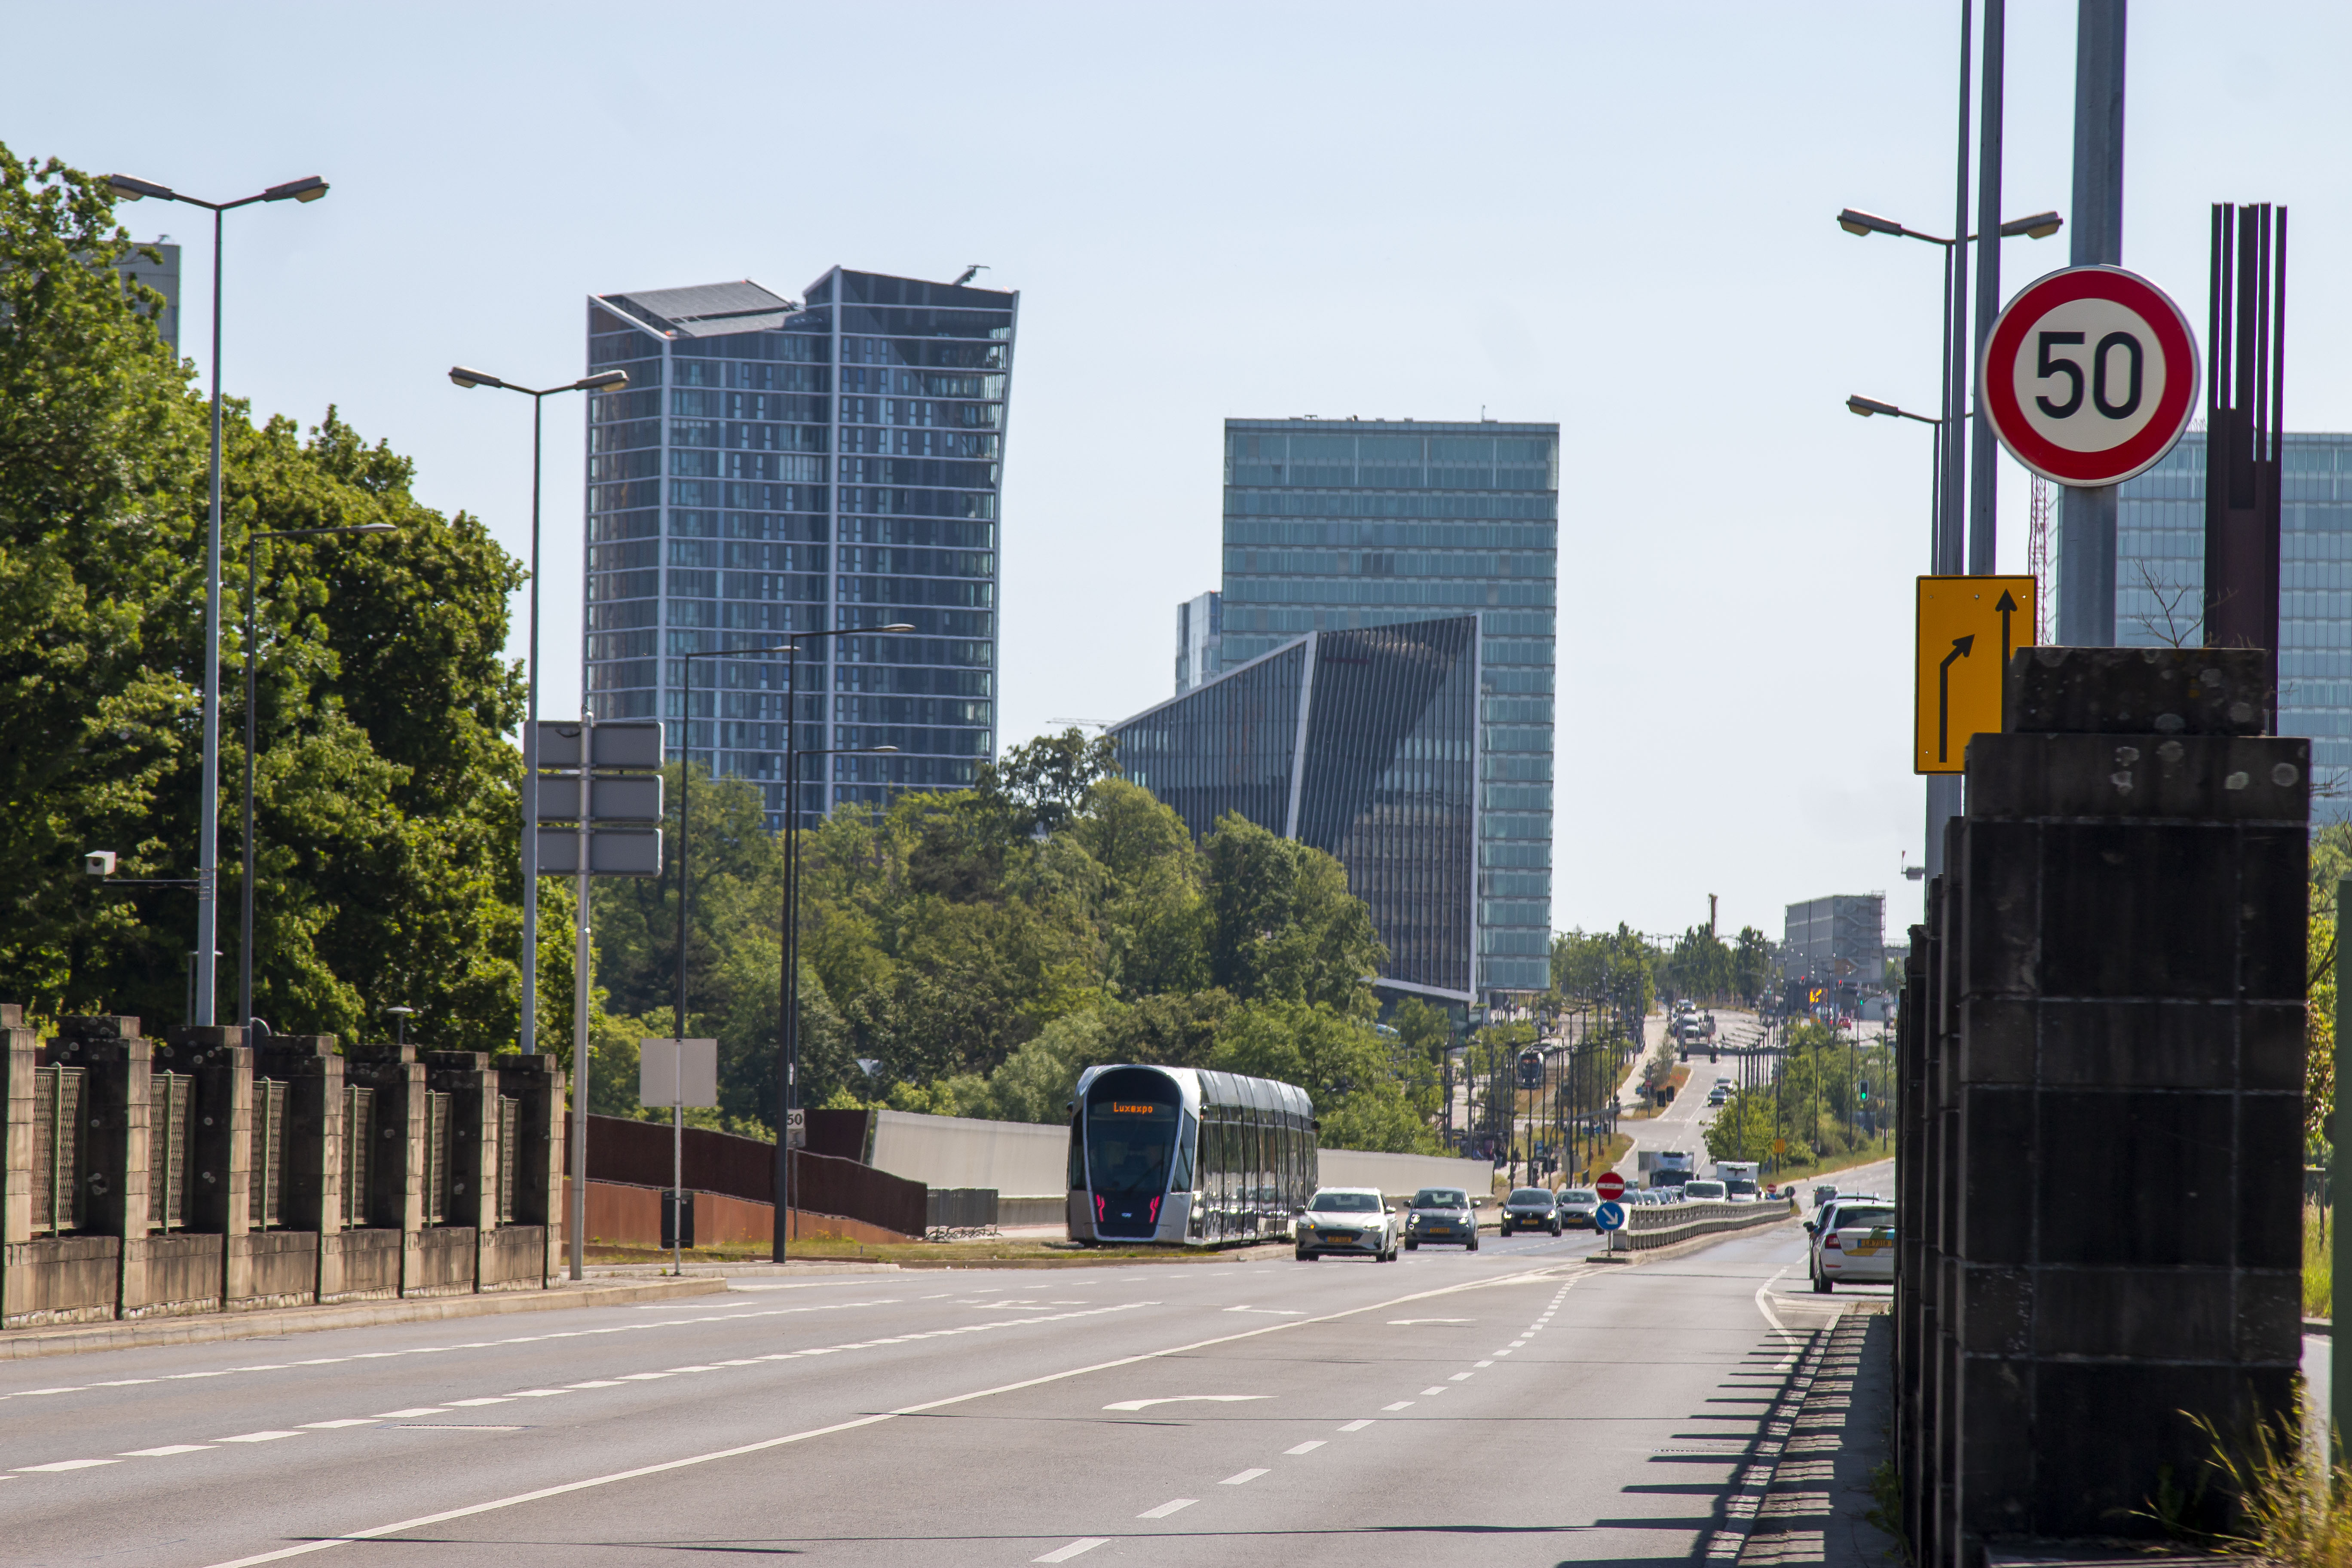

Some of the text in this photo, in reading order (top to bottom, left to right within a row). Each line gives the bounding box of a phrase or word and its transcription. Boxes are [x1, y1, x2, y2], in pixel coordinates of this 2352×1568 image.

[2035, 331, 2144, 420] 50
[1114, 1102, 1153, 1115] Luxexpo
[787, 1114, 802, 1125] 50
